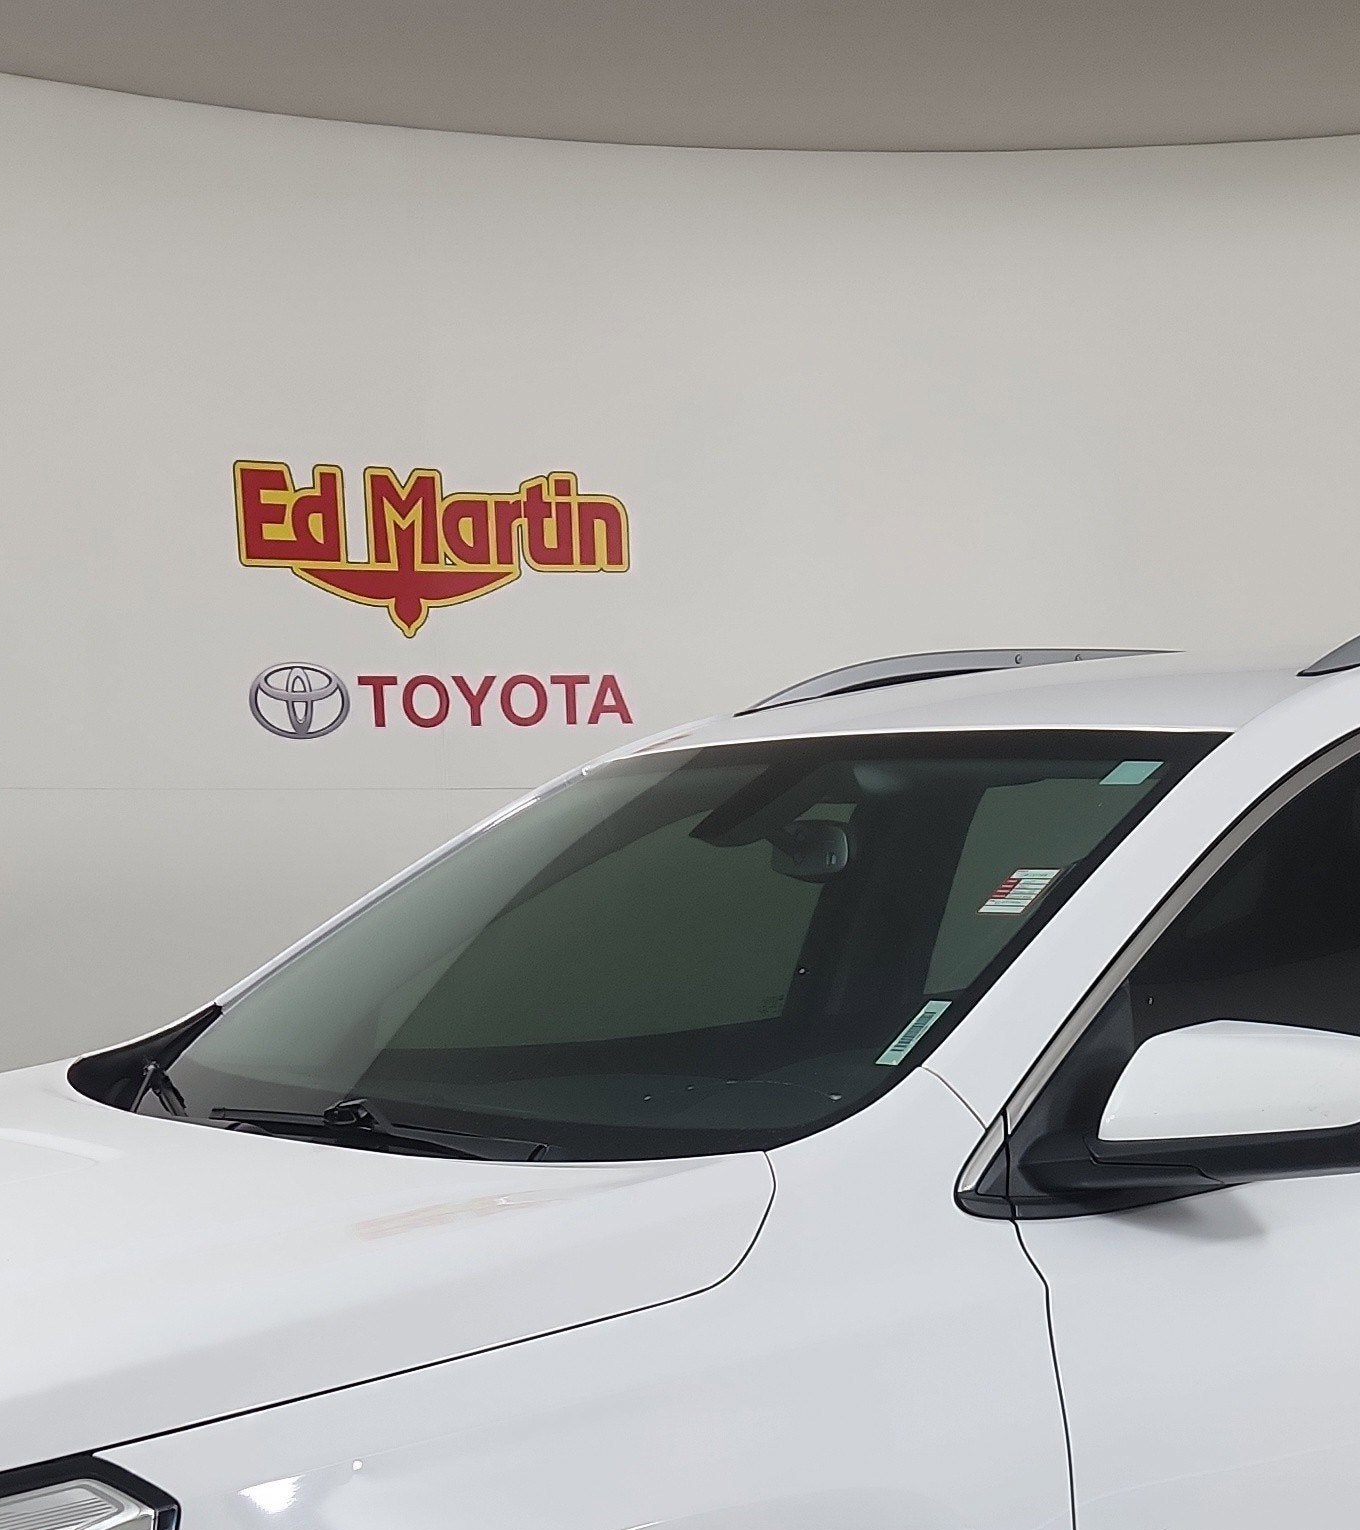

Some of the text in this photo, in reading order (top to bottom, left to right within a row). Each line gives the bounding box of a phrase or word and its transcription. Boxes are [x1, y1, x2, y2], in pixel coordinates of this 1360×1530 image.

[233, 460, 630, 572] Ed Martin
[357, 675, 633, 728] TOYOTA
